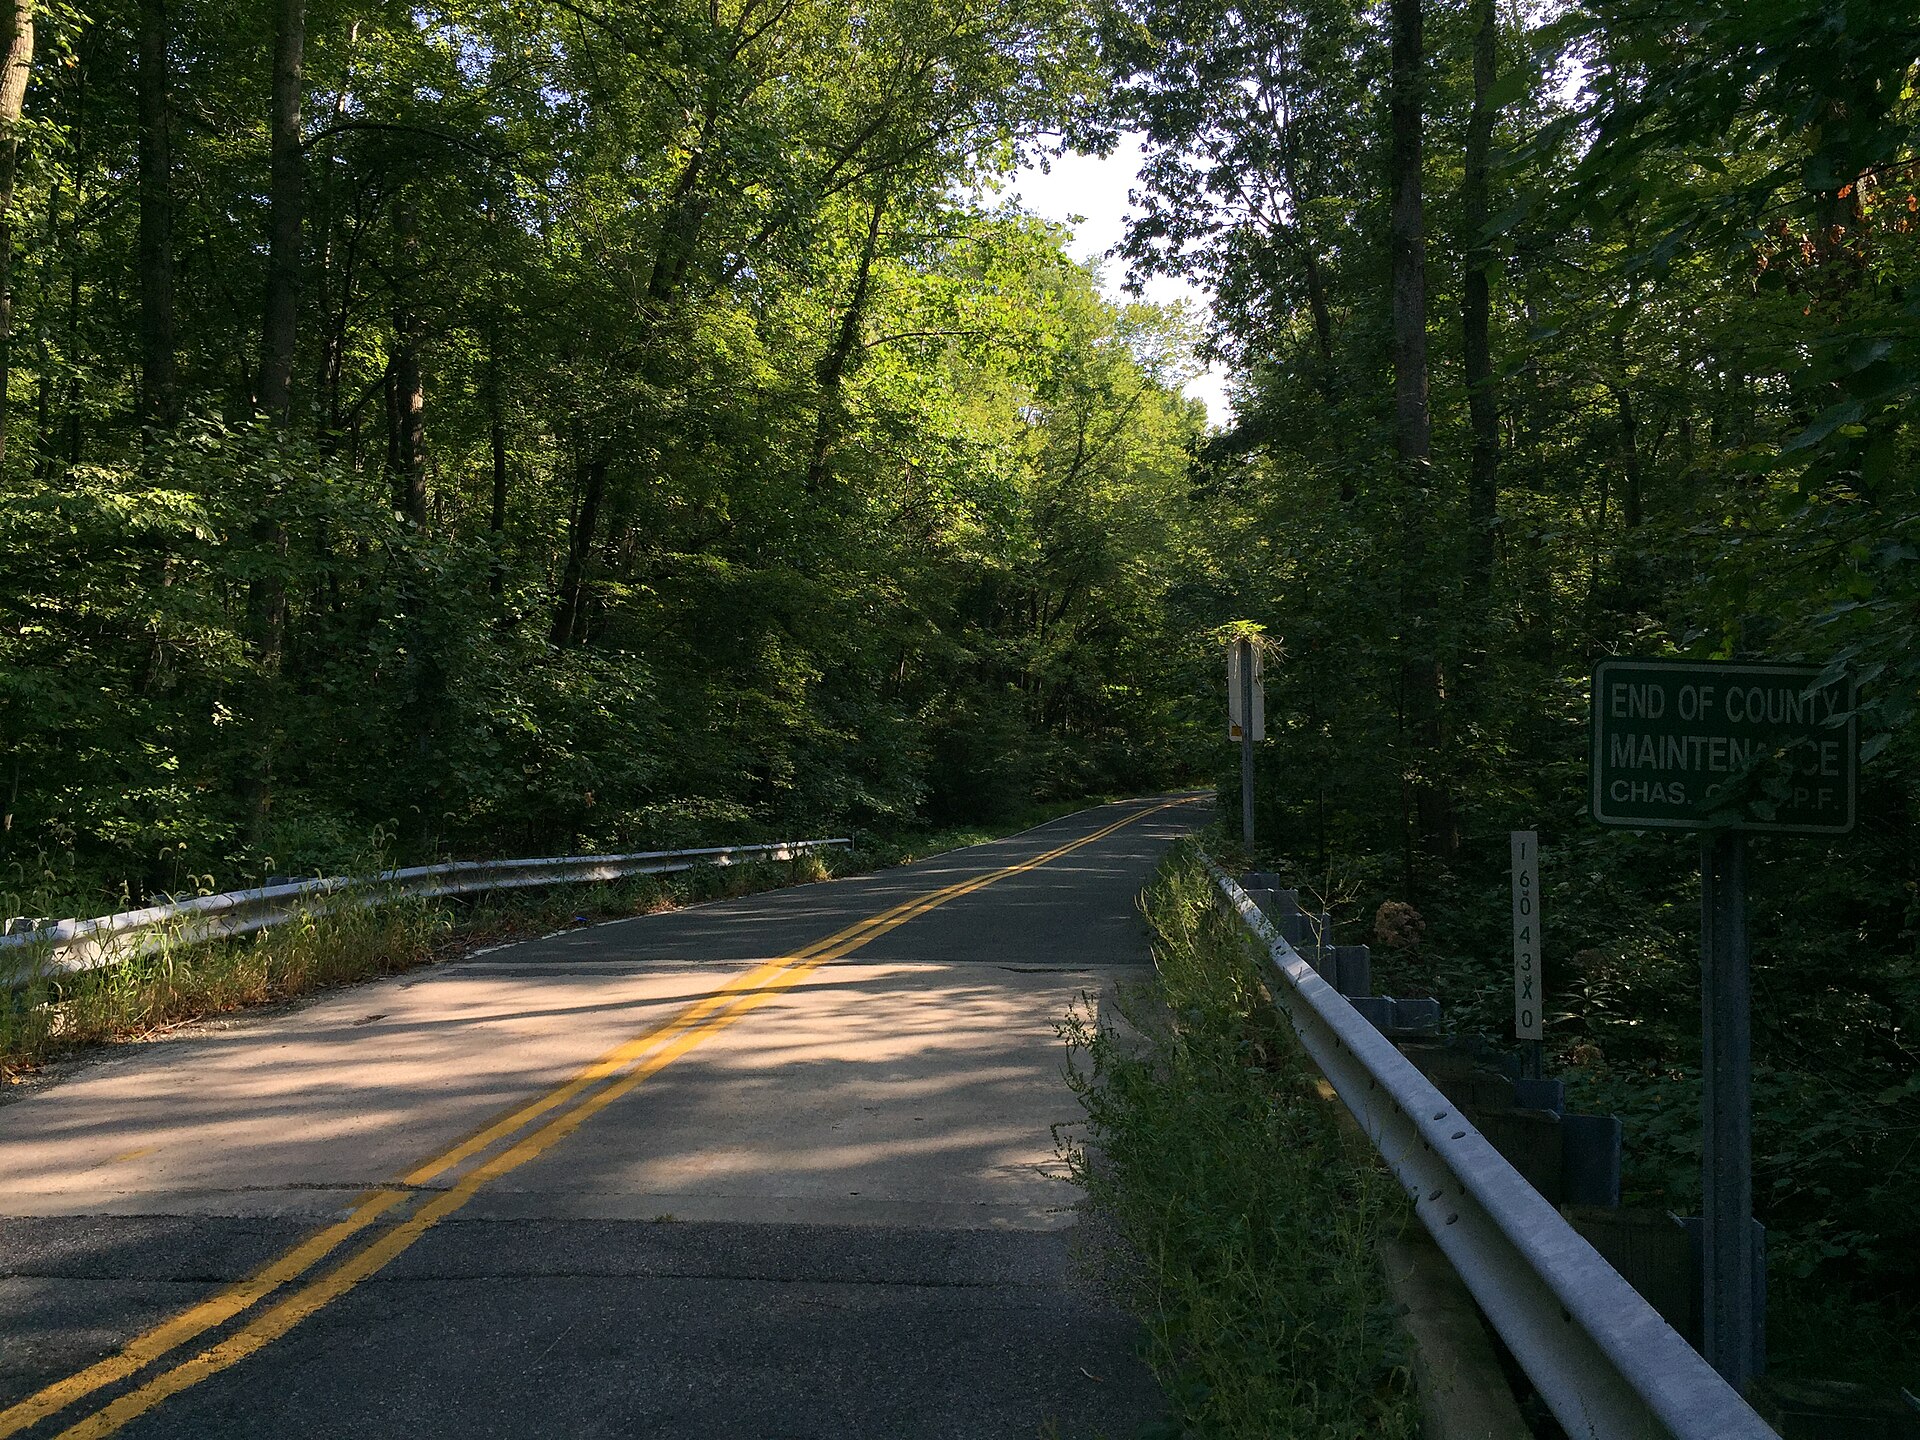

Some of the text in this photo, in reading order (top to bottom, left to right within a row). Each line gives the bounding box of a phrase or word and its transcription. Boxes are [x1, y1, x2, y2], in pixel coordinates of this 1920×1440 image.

[1610, 683, 1839, 725] END OF COUNTY
[1609, 733, 1840, 776] MAINTENCE
[1610, 780, 1693, 805] CHAS.
